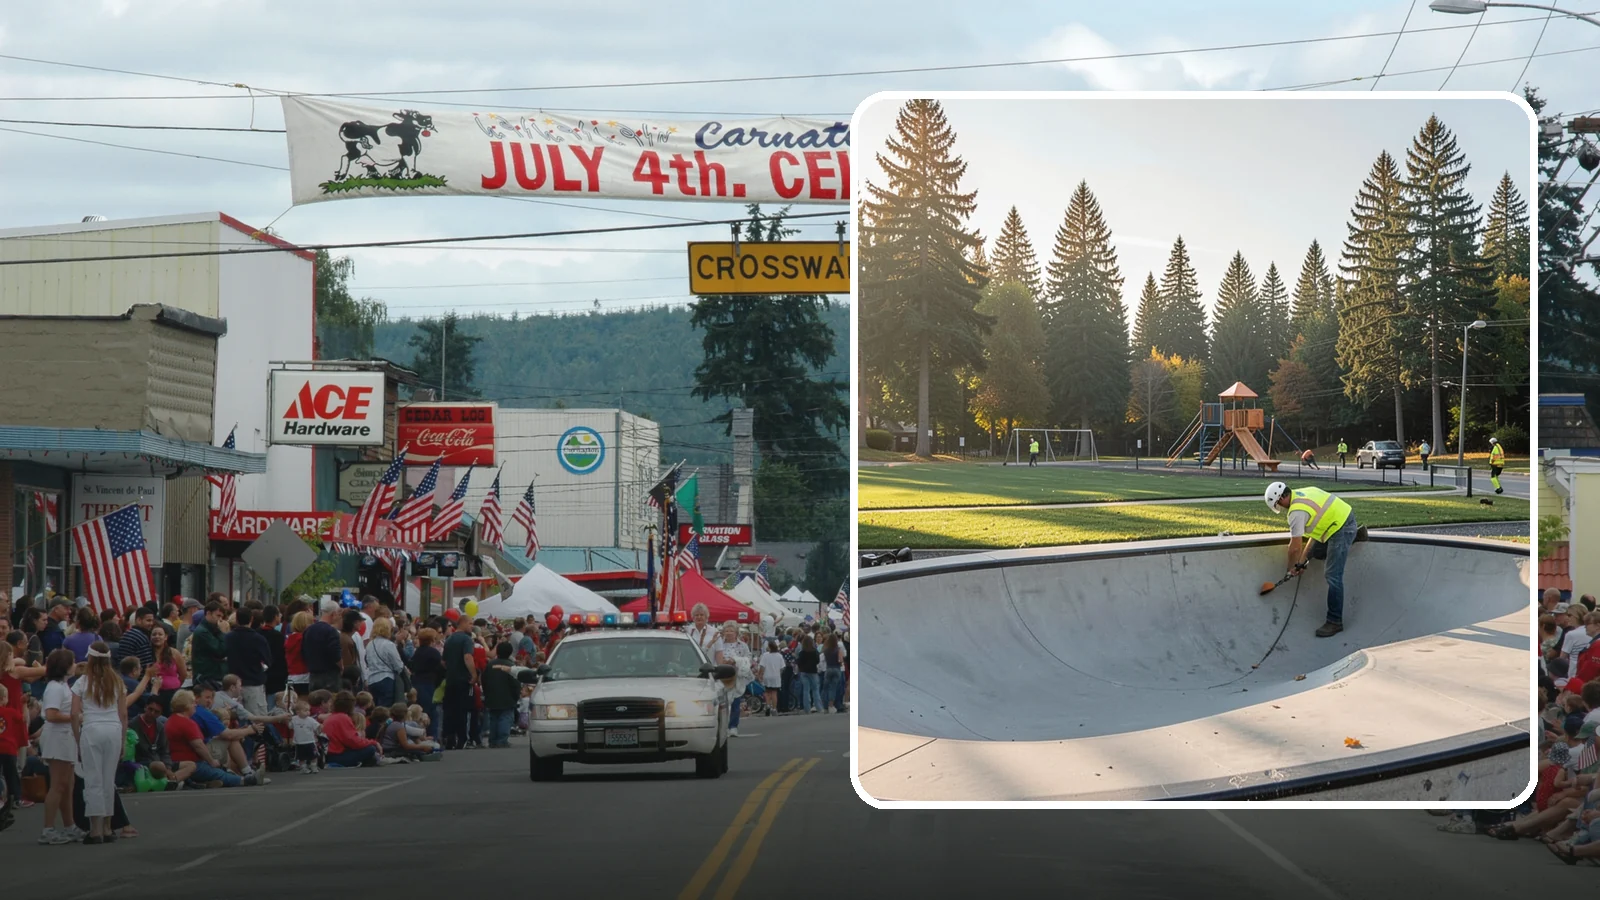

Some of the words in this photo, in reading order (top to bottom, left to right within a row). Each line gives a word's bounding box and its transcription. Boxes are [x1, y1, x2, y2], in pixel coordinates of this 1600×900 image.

[694, 121, 850, 150] Carnat
[481, 140, 605, 193] JULY
[632, 149, 746, 198] 4th.
[696, 253, 850, 280] CROSSWA
[282, 379, 374, 420] ACE
[405, 408, 453, 422] CEDAR
[283, 420, 371, 437] Hardware
[353, 467, 385, 480] Simpl
[83, 484, 94, 494] St.
[95, 485, 124, 495] Vincent
[126, 485, 136, 495] de
[137, 485, 155, 495] Paul
[81, 503, 154, 522] THT
[688, 526, 742, 535] CRNATION
[699, 535, 730, 544] GLASS
